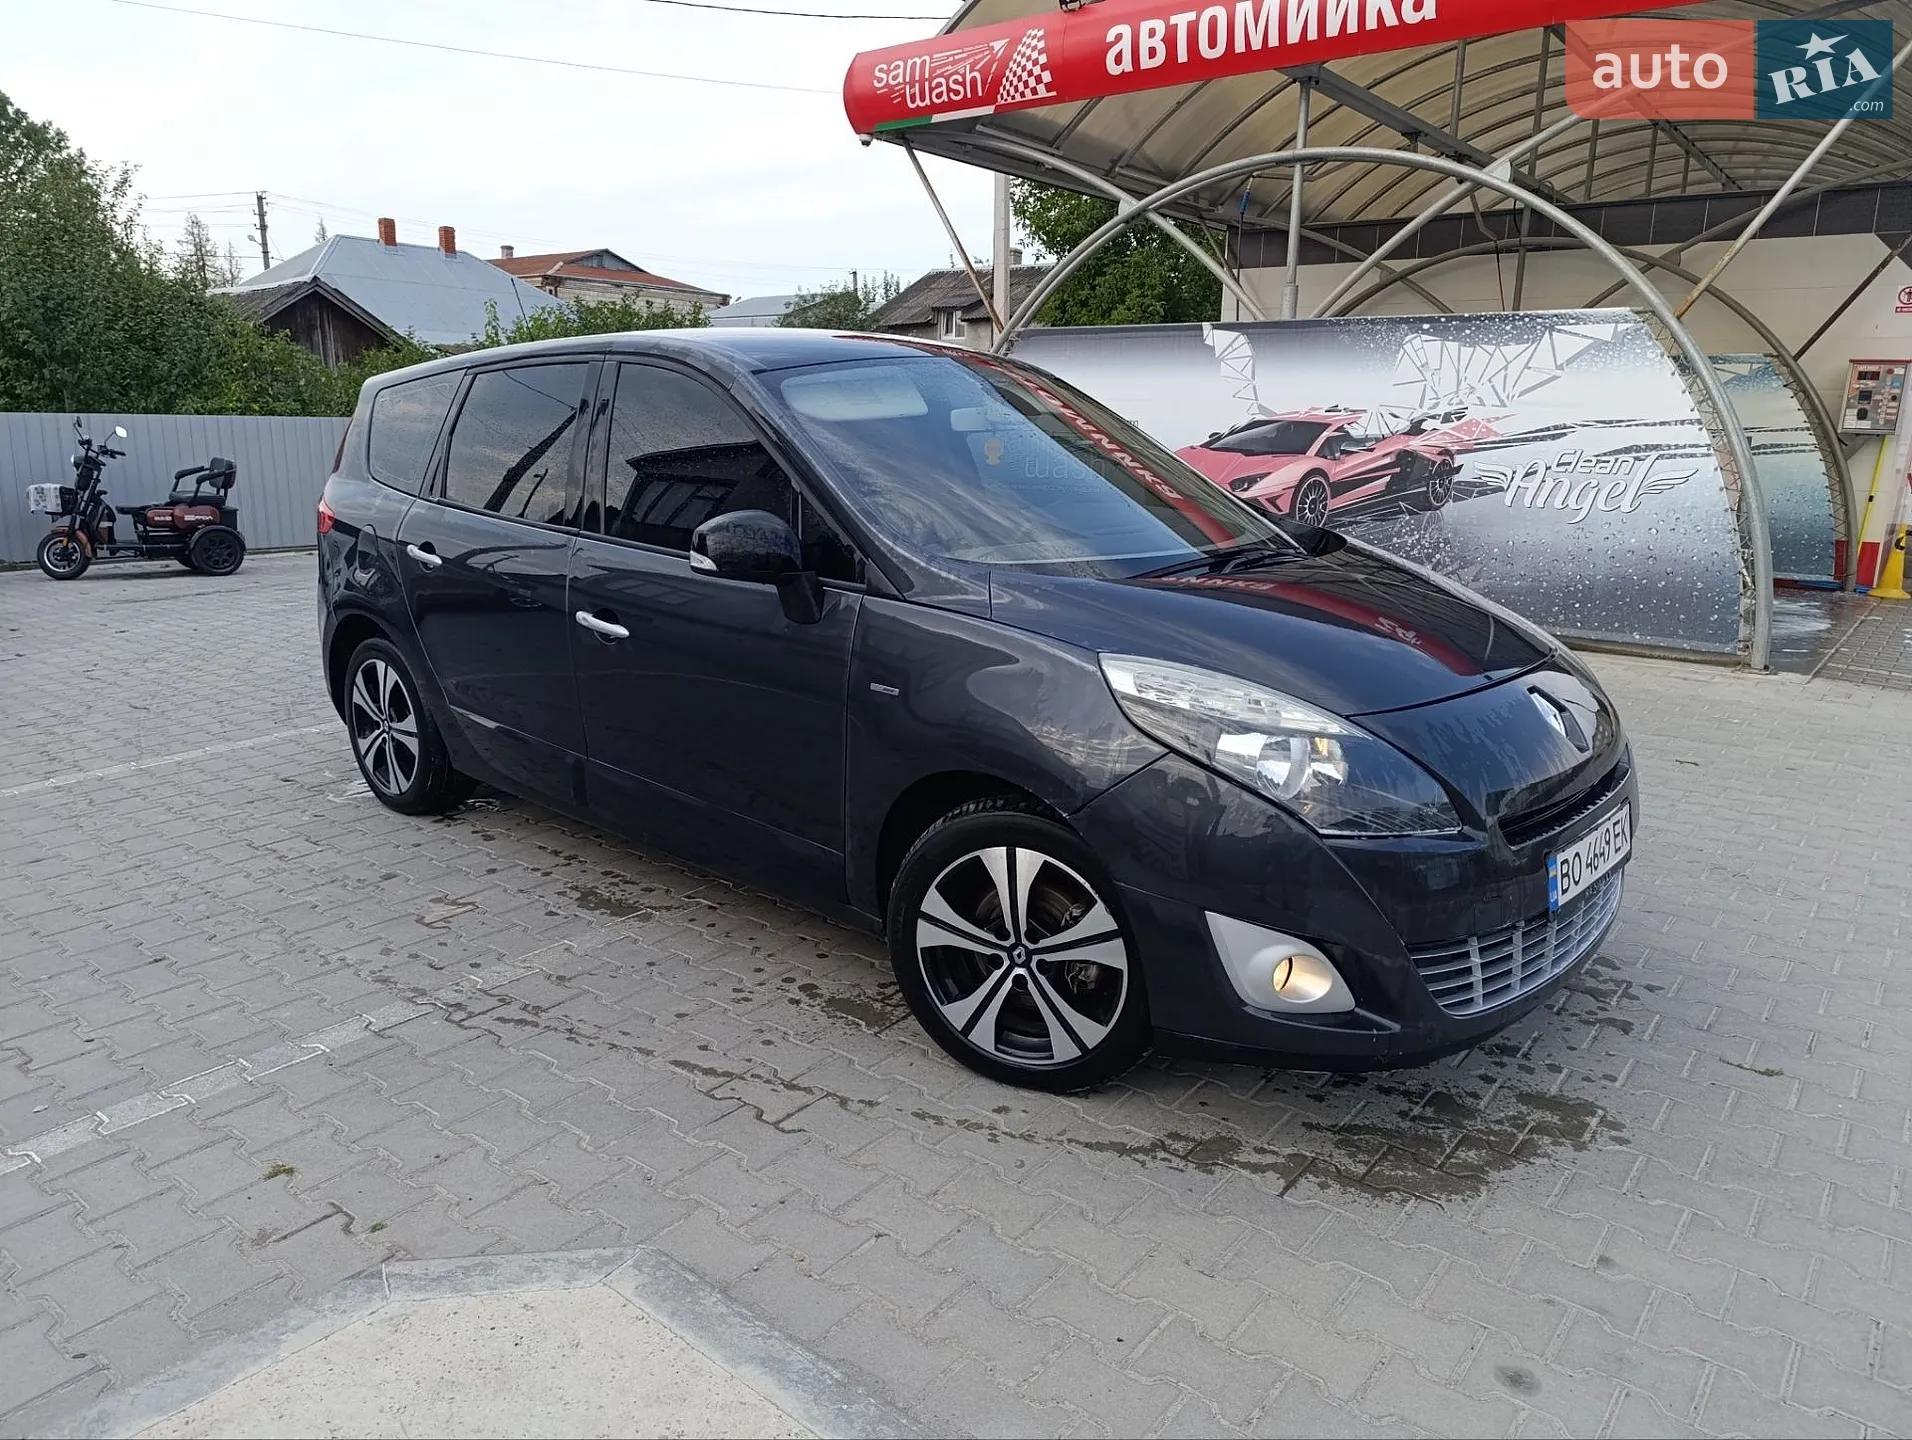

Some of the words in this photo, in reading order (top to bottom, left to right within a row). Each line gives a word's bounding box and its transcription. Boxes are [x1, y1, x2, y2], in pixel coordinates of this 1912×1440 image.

[873, 55, 932, 88] sam
[906, 65, 984, 109] wash
[1551, 449, 1636, 475] Clean
[1503, 453, 1661, 525] Angel
[1560, 851, 1582, 896] BO
